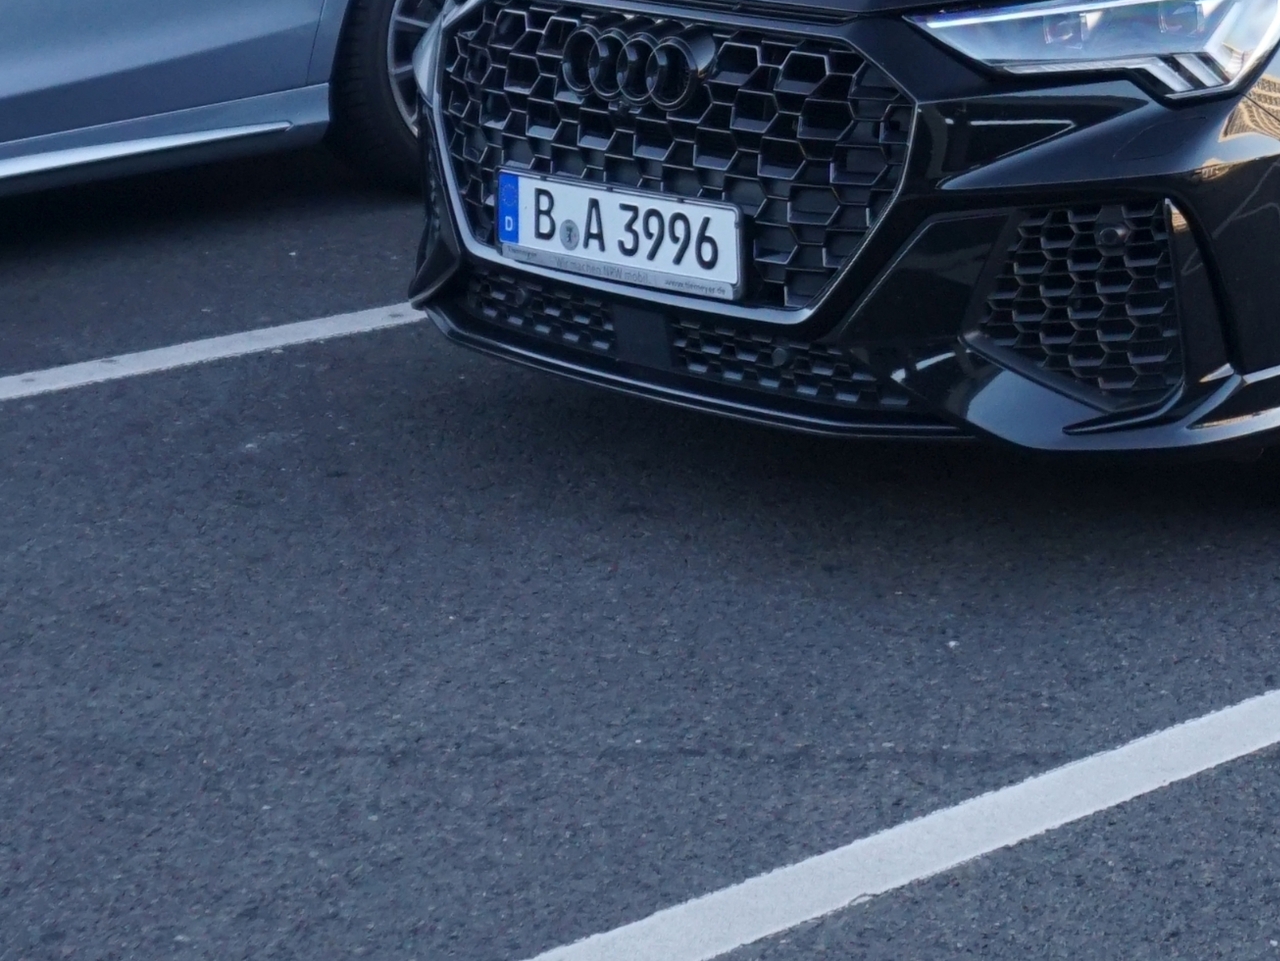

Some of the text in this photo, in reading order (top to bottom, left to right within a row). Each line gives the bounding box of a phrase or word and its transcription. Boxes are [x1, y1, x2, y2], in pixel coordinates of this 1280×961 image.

[505, 215, 513, 231] D
[534, 187, 719, 271] B A 3996
[602, 265, 623, 280] NRW
